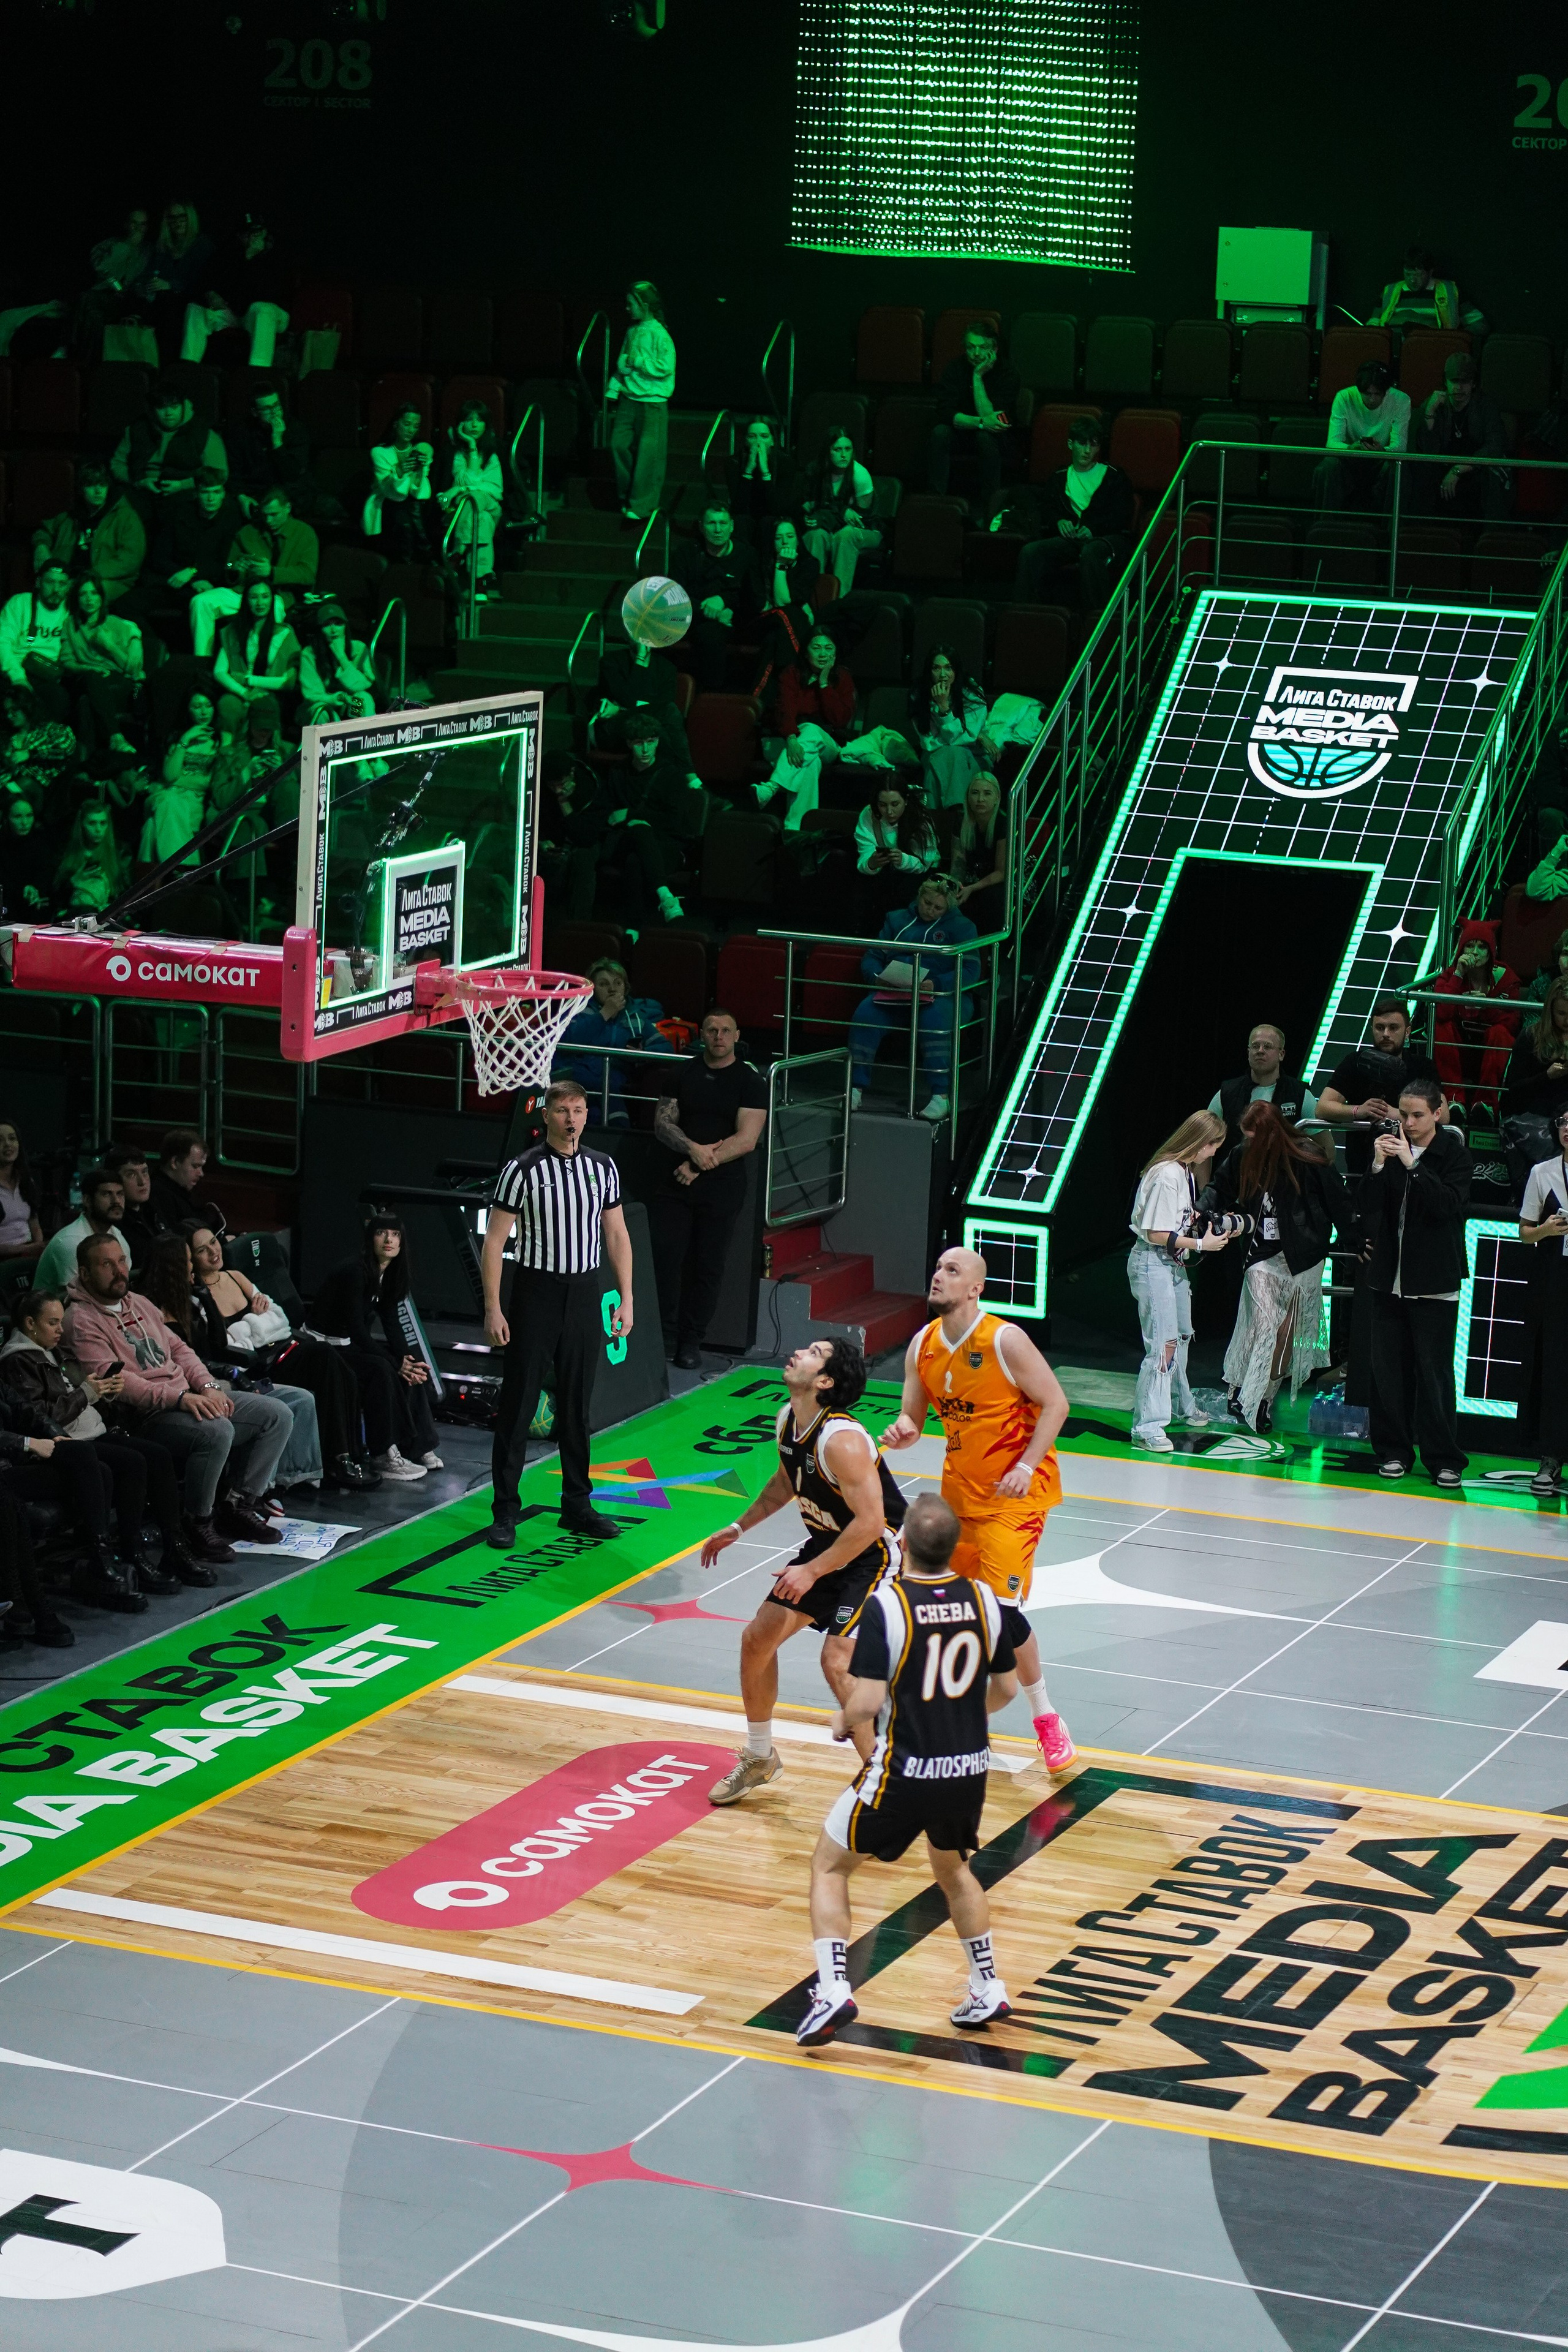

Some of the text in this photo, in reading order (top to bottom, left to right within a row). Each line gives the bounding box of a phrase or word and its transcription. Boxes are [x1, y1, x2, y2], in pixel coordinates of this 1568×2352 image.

[263, 38, 373, 91] 208
[1512, 137, 1567, 150] СЕКТОР
[1256, 705, 1400, 733] MEDIA
[1250, 725, 1399, 748] BASKET
[400, 906, 451, 935] MEDIA
[399, 925, 451, 952] BASKET
[914, 1600, 978, 1625] CHEBA
[921, 1630, 981, 1702] 10
[74, 1623, 440, 1787] BASKET
[1082, 1833, 1520, 2111] MEDIA
